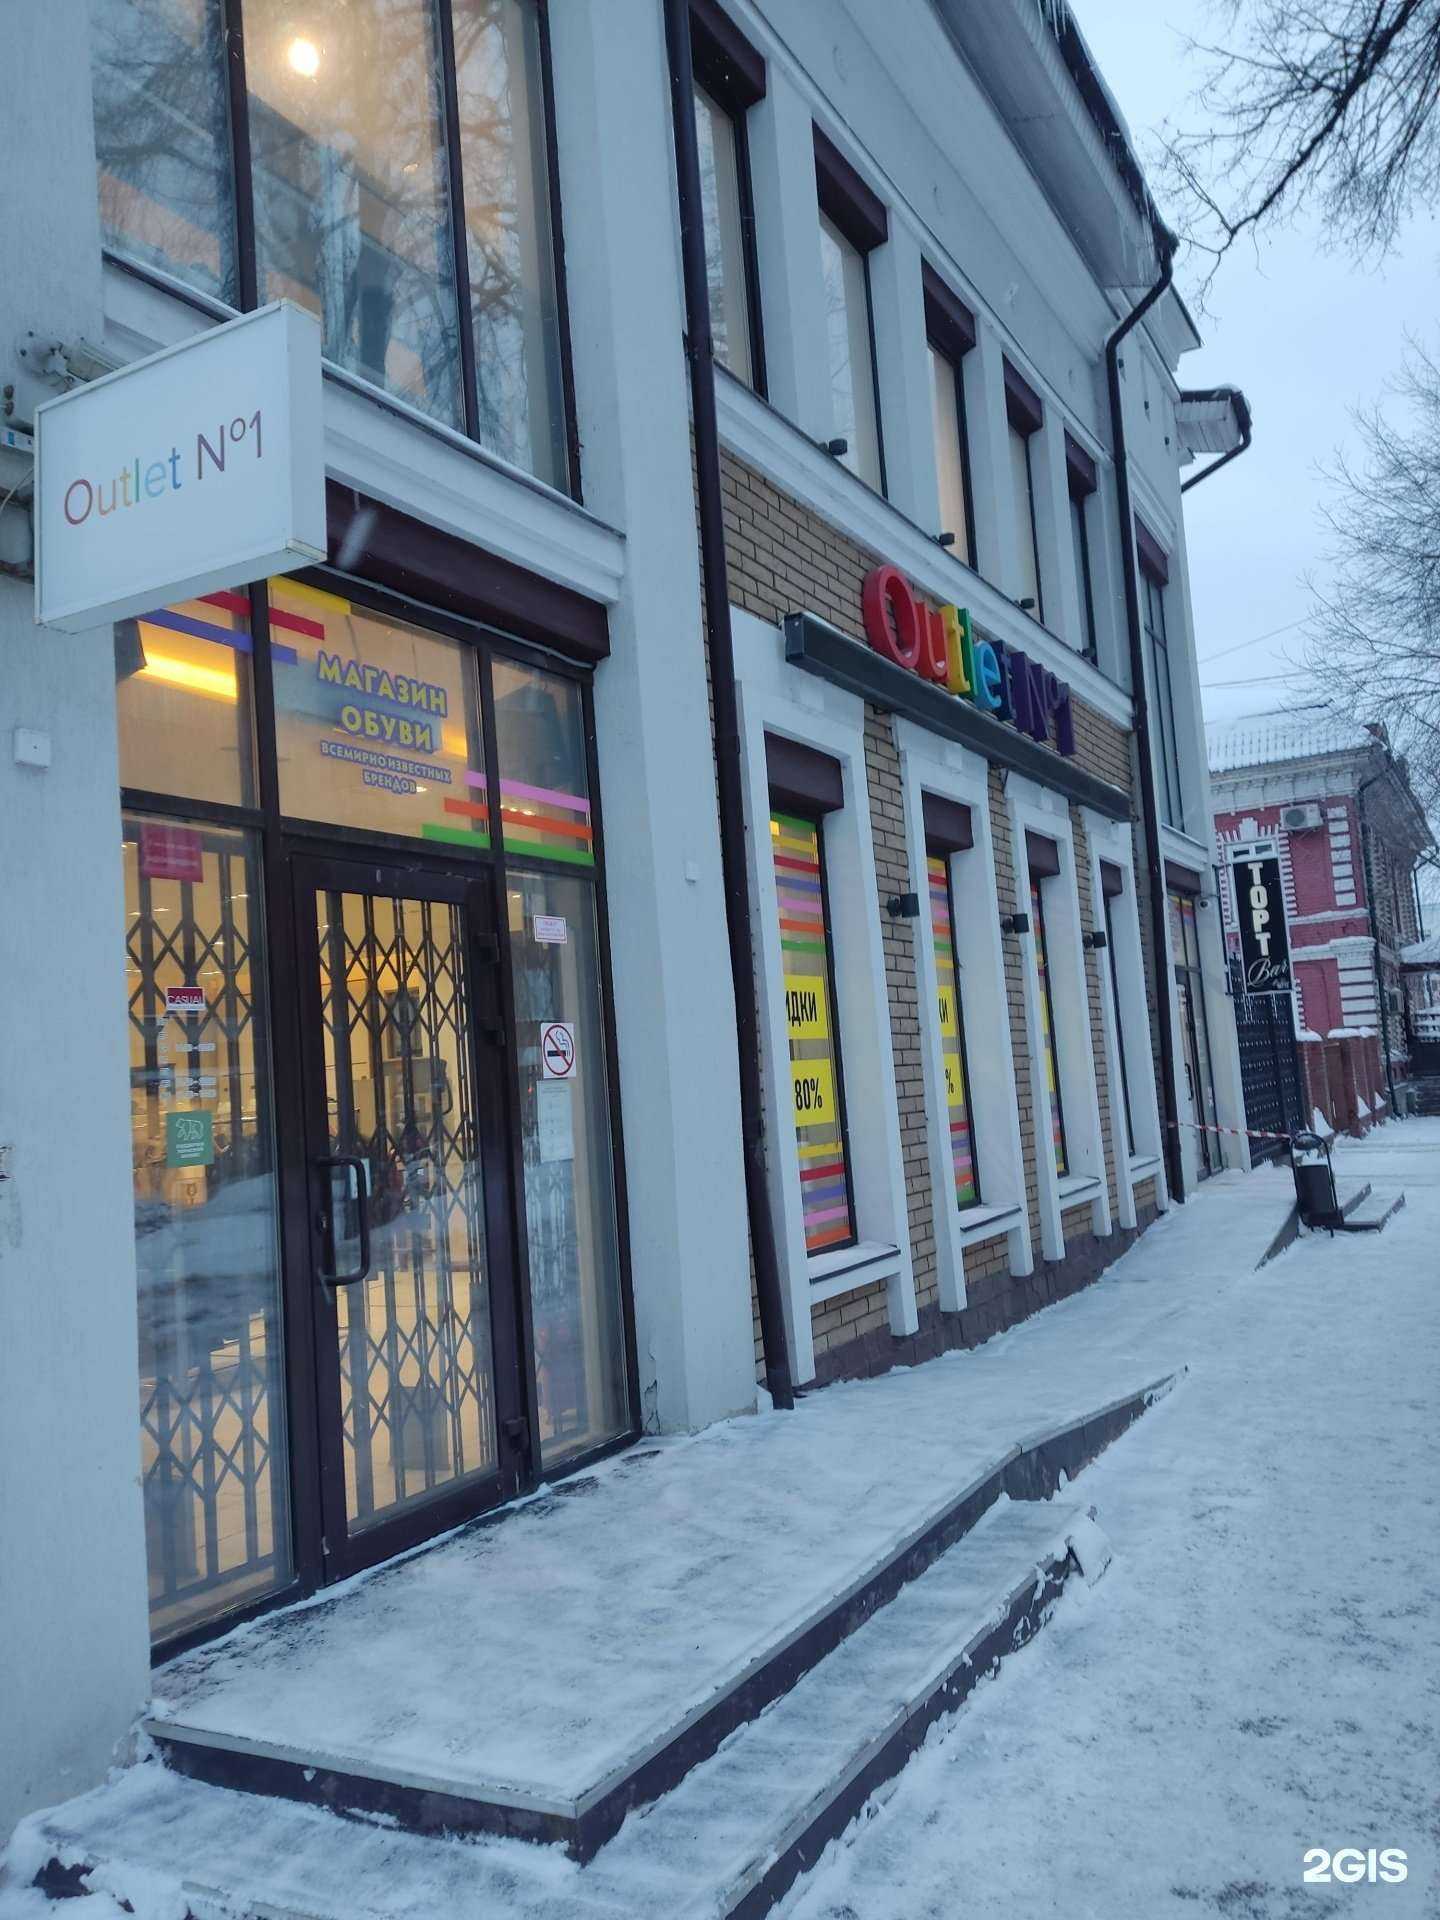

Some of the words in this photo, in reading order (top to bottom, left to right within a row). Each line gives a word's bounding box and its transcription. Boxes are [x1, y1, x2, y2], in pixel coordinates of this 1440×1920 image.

[64, 447, 181, 525] Outlet
[863, 564, 1013, 721] Outlet
[317, 650, 448, 718] МАГАЗИН
[340, 705, 433, 753] ОБУВИ
[363, 769, 416, 794] БРЕНДОВ
[794, 1077, 823, 1111] 80%
